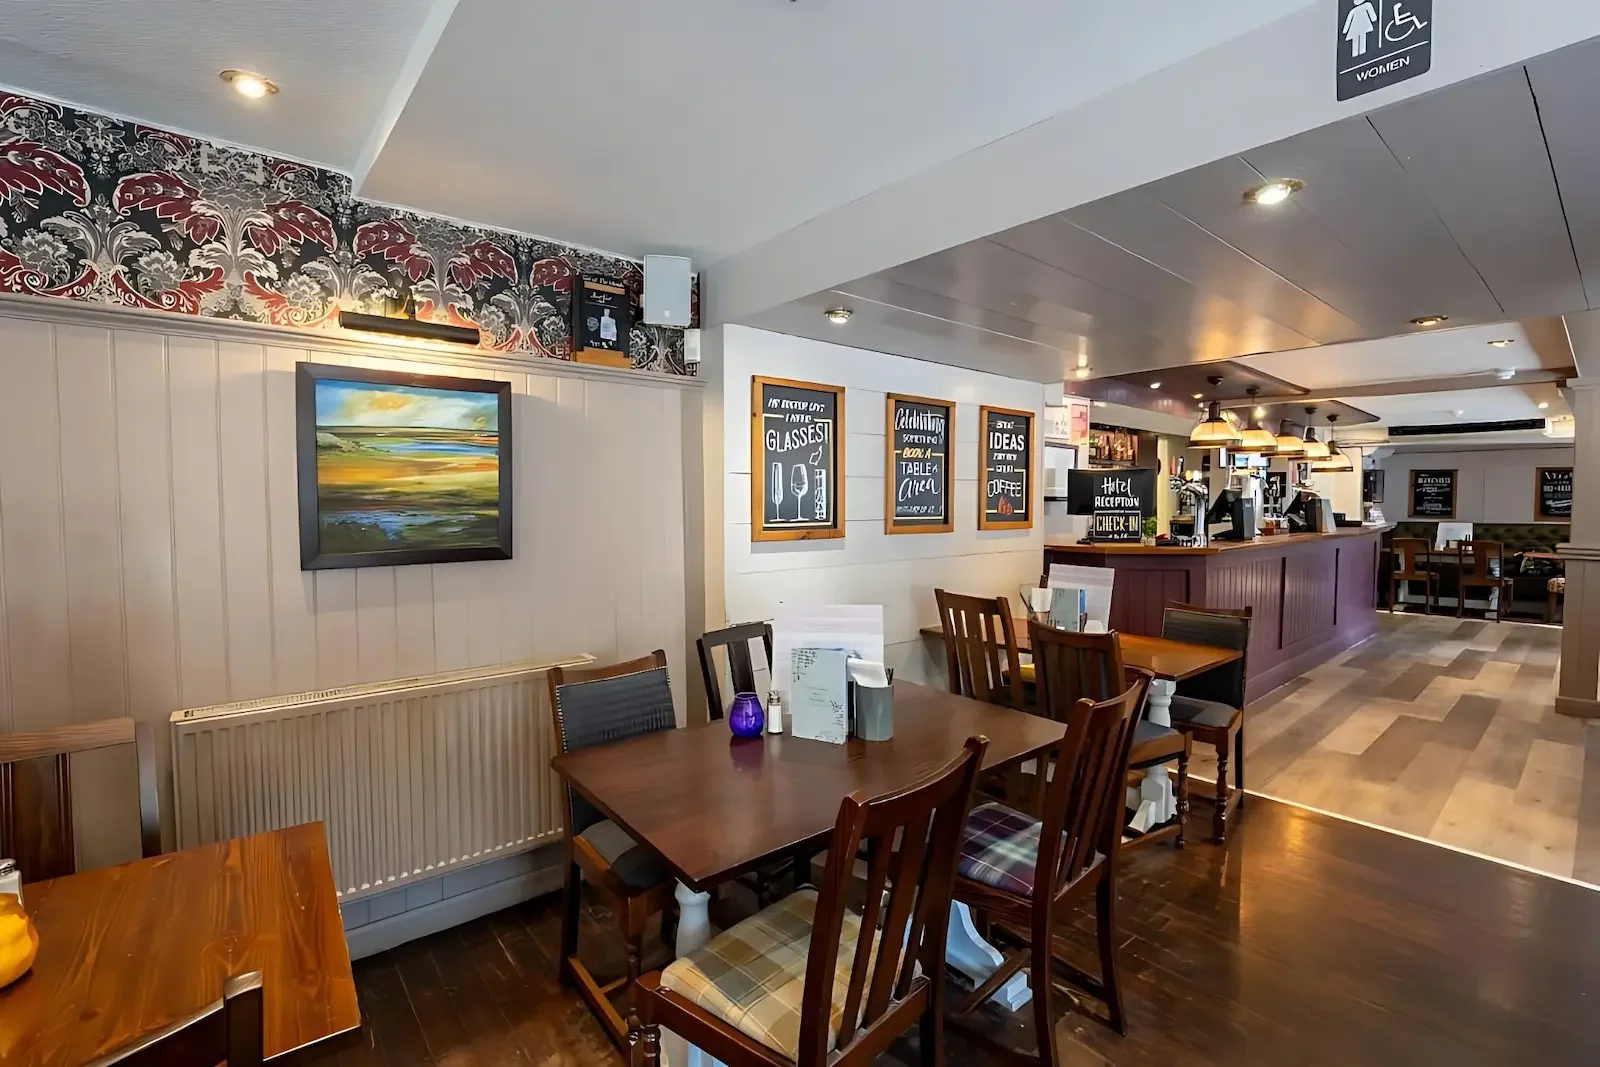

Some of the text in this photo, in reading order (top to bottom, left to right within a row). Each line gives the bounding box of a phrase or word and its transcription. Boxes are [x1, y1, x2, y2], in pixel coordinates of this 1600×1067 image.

[1356, 56, 1410, 81] WOMEN
[990, 431, 1025, 451] IDEAS
[900, 461, 932, 475] TABLE
[988, 479, 1021, 497] COFFEE
[1101, 477, 1134, 497] Hotel
